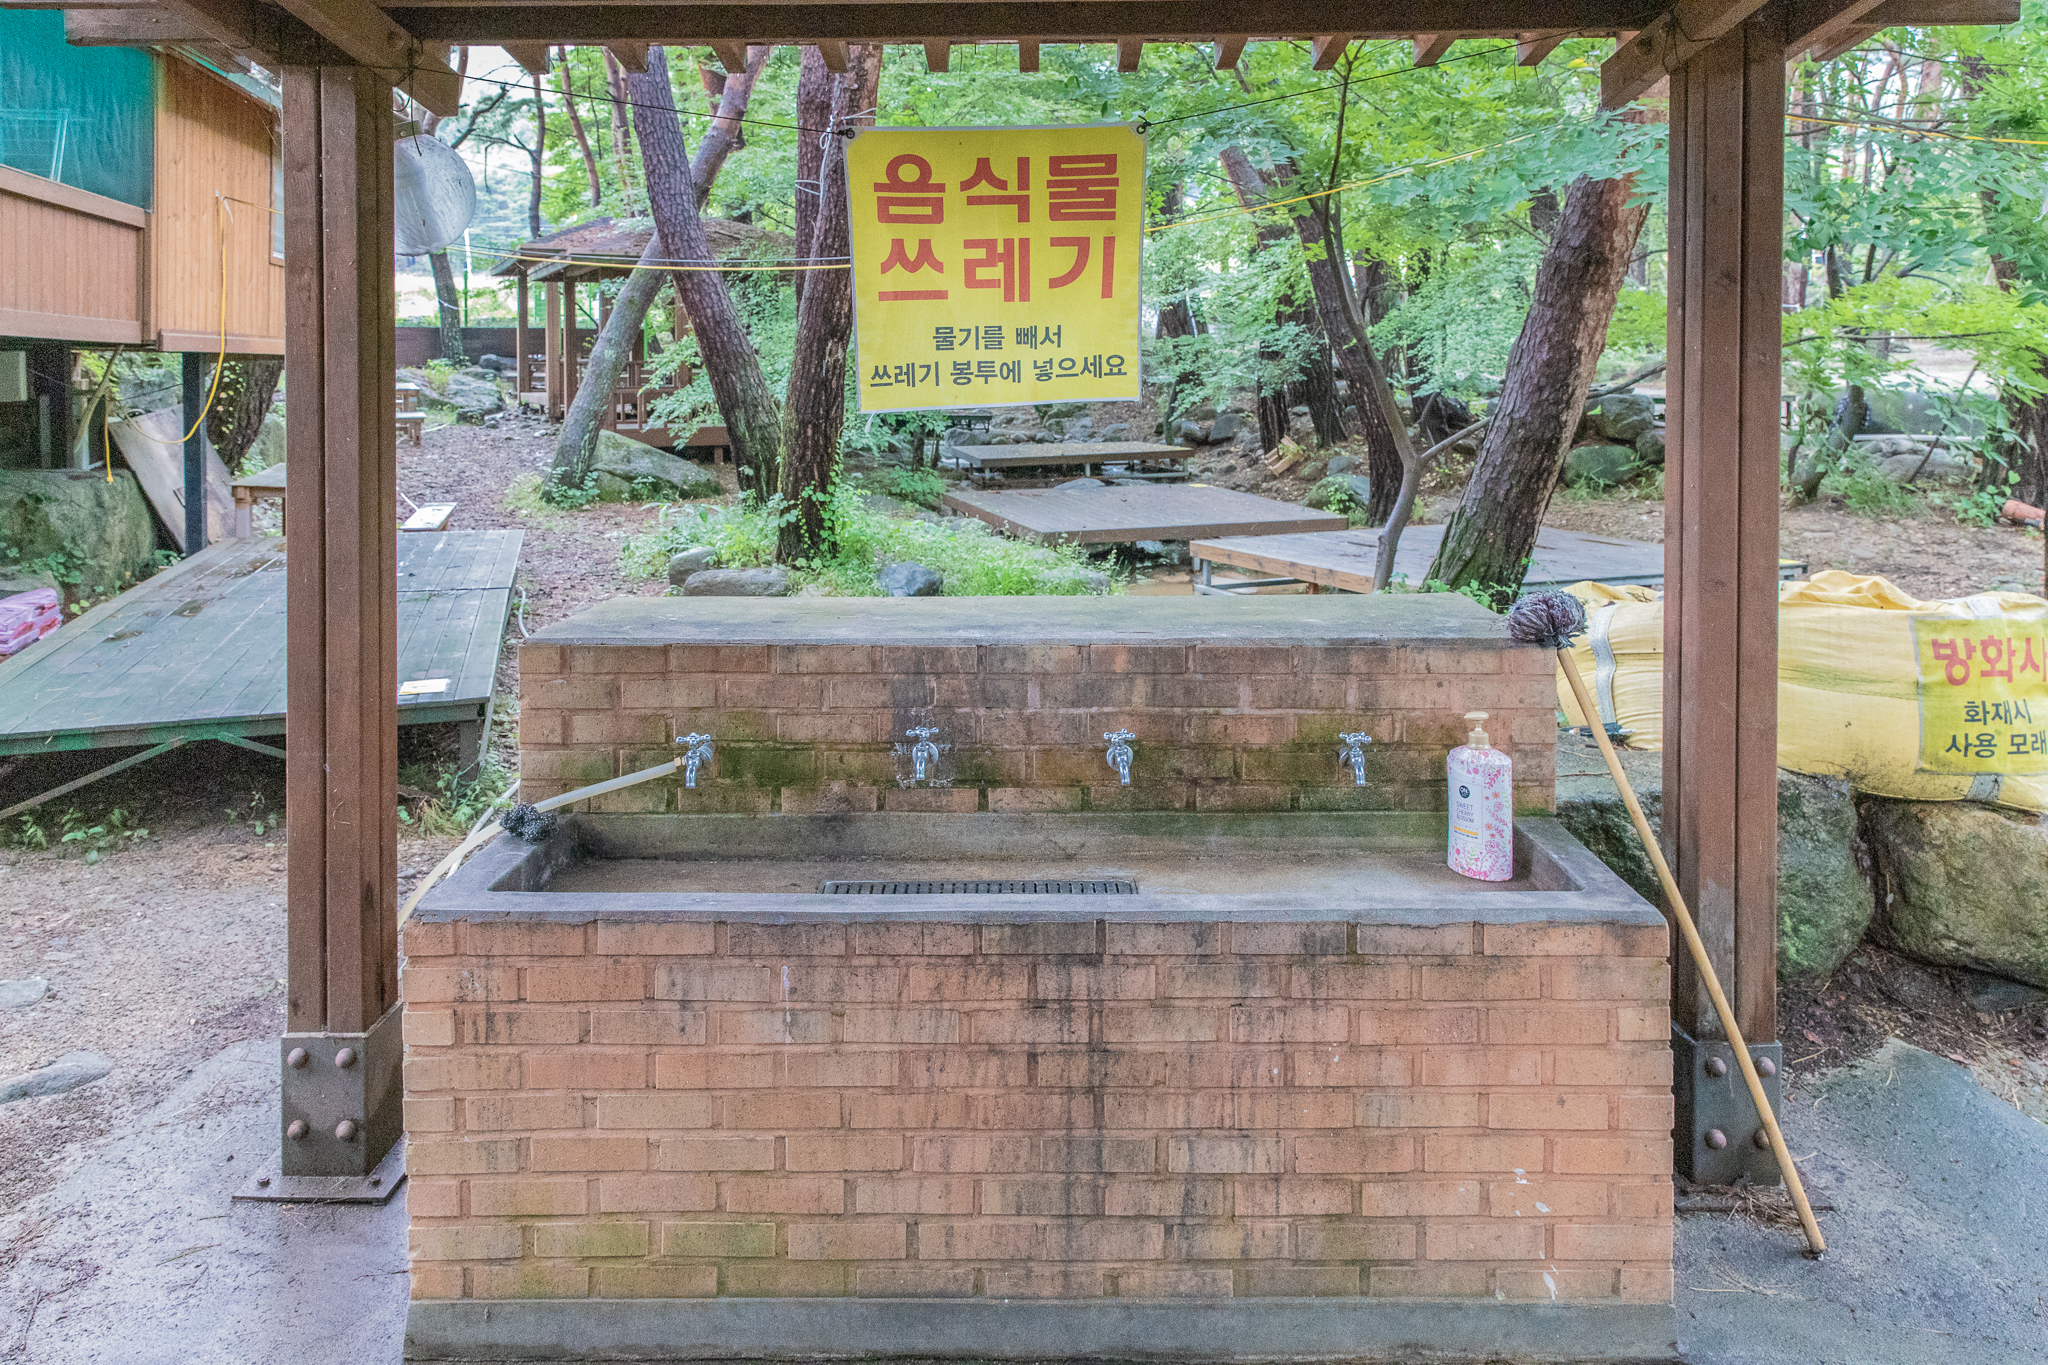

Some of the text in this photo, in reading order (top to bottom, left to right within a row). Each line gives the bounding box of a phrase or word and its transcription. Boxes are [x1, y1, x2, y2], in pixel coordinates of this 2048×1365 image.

[874, 153, 1119, 224] 음식물
[878, 236, 1116, 302] 쓰레기
[933, 325, 1062, 350] 물기를 빼서
[870, 354, 1127, 387] 쓰레기 봉투에 넣으세요
[1931, 635, 2047, 686] 방화사
[1964, 699, 2032, 725] 화재시
[1945, 730, 2047, 758] 사용 모래
[1456, 801, 1473, 811] SWEET
[1456, 808, 1473, 817] CHERRY
